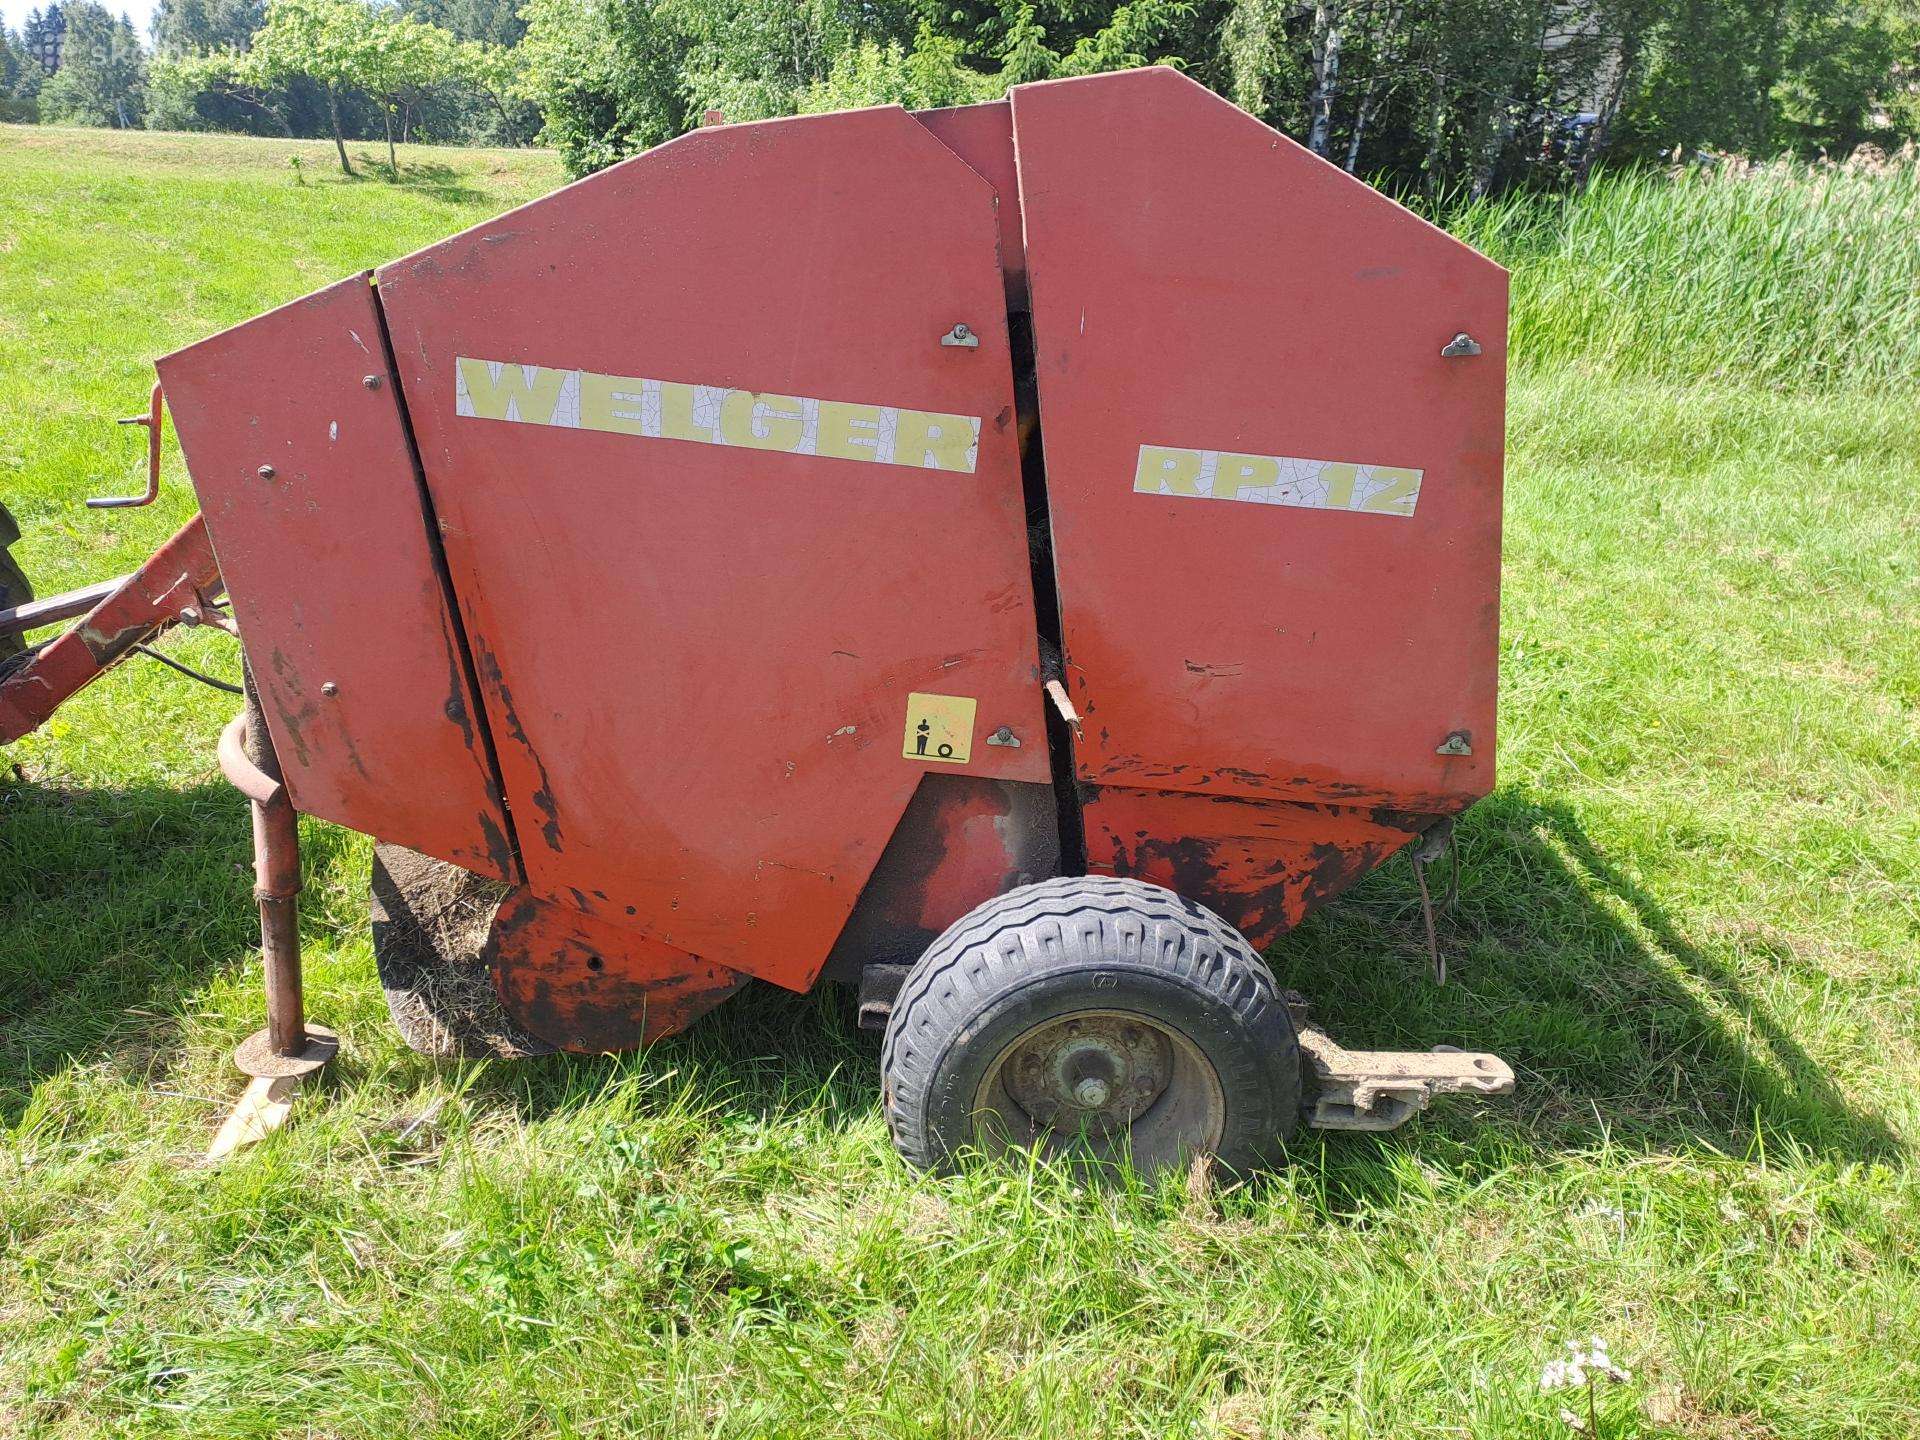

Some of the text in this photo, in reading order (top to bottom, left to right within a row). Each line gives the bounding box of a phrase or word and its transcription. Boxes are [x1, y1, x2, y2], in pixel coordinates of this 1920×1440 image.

[457, 357, 977, 474] WELGER
[1136, 449, 1421, 515] RP 12
